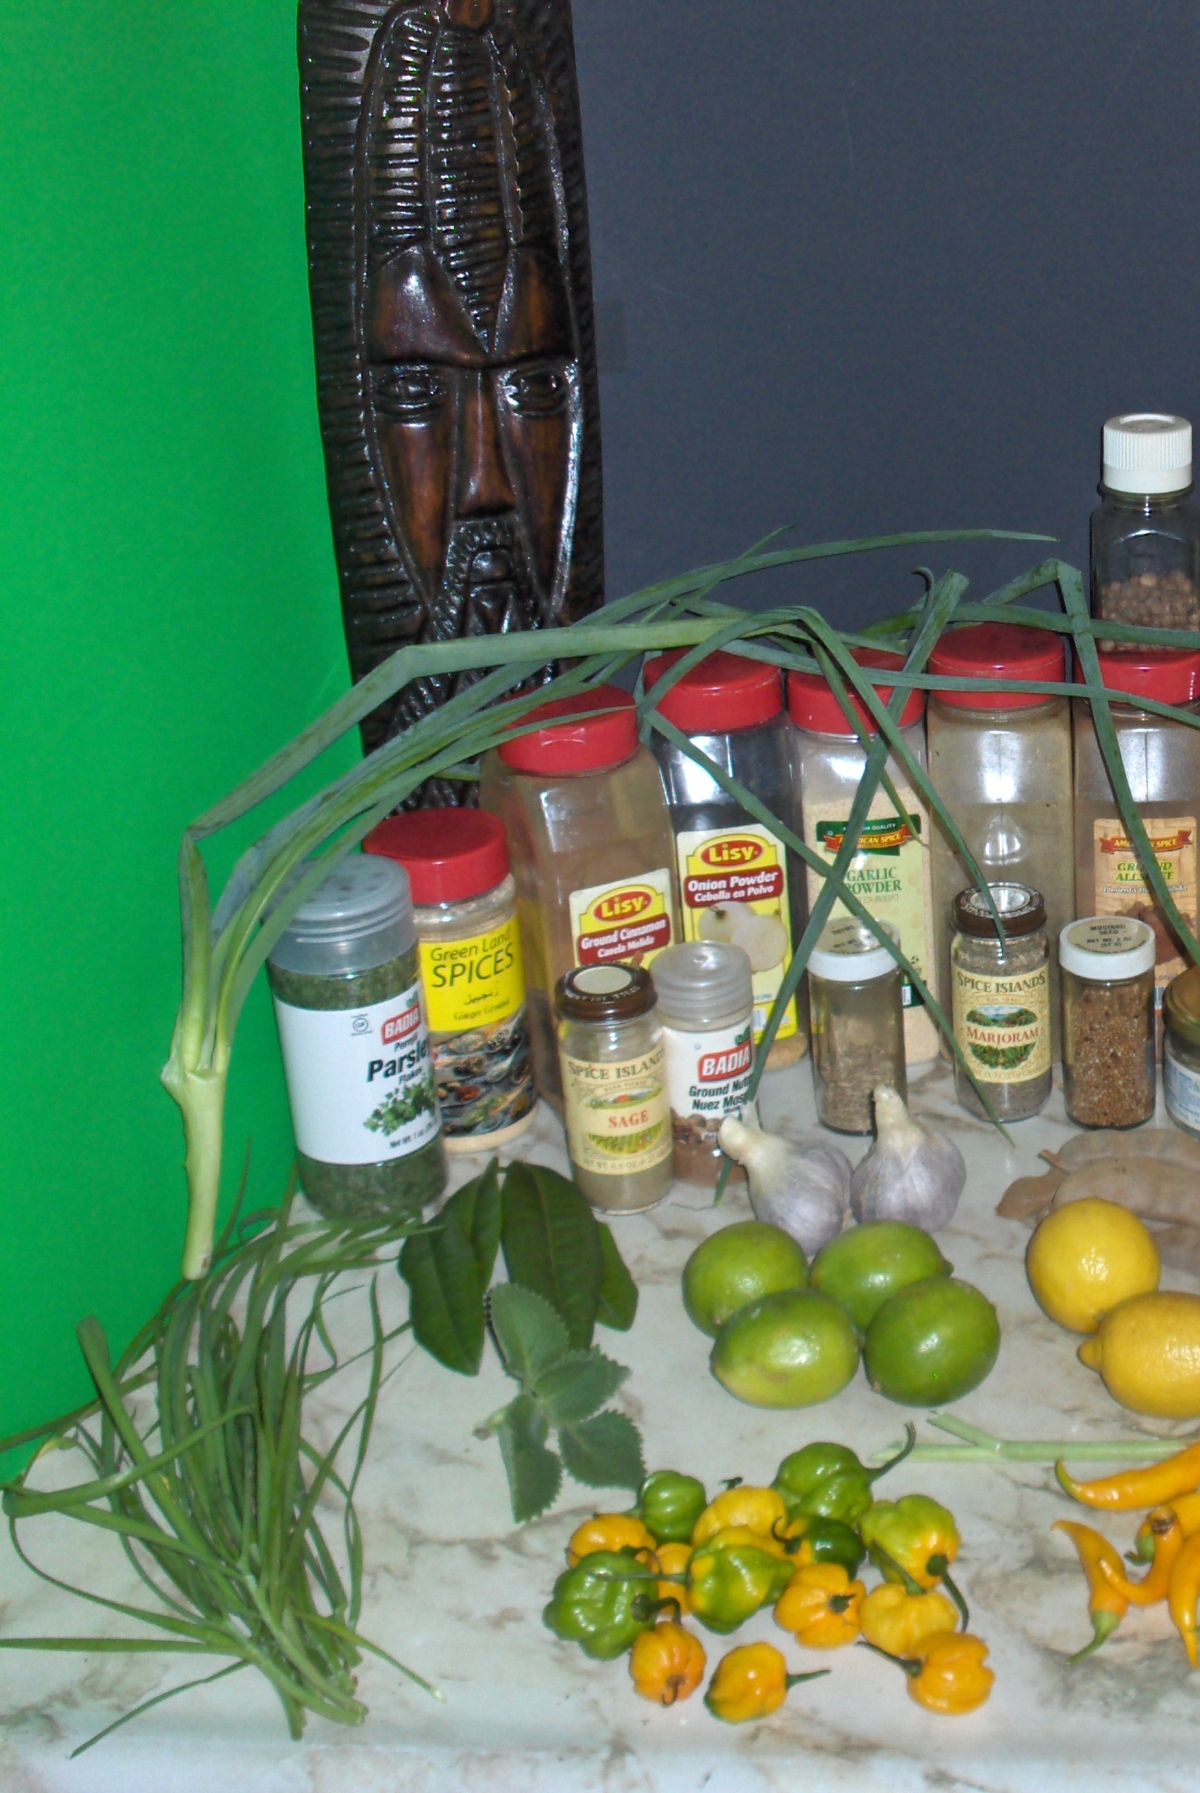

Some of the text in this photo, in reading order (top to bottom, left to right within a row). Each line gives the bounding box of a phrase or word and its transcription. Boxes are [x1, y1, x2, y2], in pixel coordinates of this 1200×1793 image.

[708, 843, 756, 863] Lisy
[687, 871, 779, 892] Onion Powder
[846, 866, 897, 882] GARLIC
[694, 885, 775, 903] Cebolla en Polvo
[600, 895, 645, 919] Lisy
[580, 918, 667, 950] Ground Cinnamon
[430, 928, 511, 962] Green Land
[431, 942, 514, 988] SPICES
[957, 970, 1047, 993] SPICE ISLANDS
[384, 1007, 421, 1038] BADIA
[966, 1027, 1040, 1046] MARJORAM
[366, 1038, 429, 1083] Parsle
[567, 1060, 610, 1080] SPICE
[701, 1045, 750, 1077] BADIA
[688, 1082, 730, 1098] Ground
[691, 1098, 731, 1111] Nuez
[607, 1109, 649, 1130] SAGE
